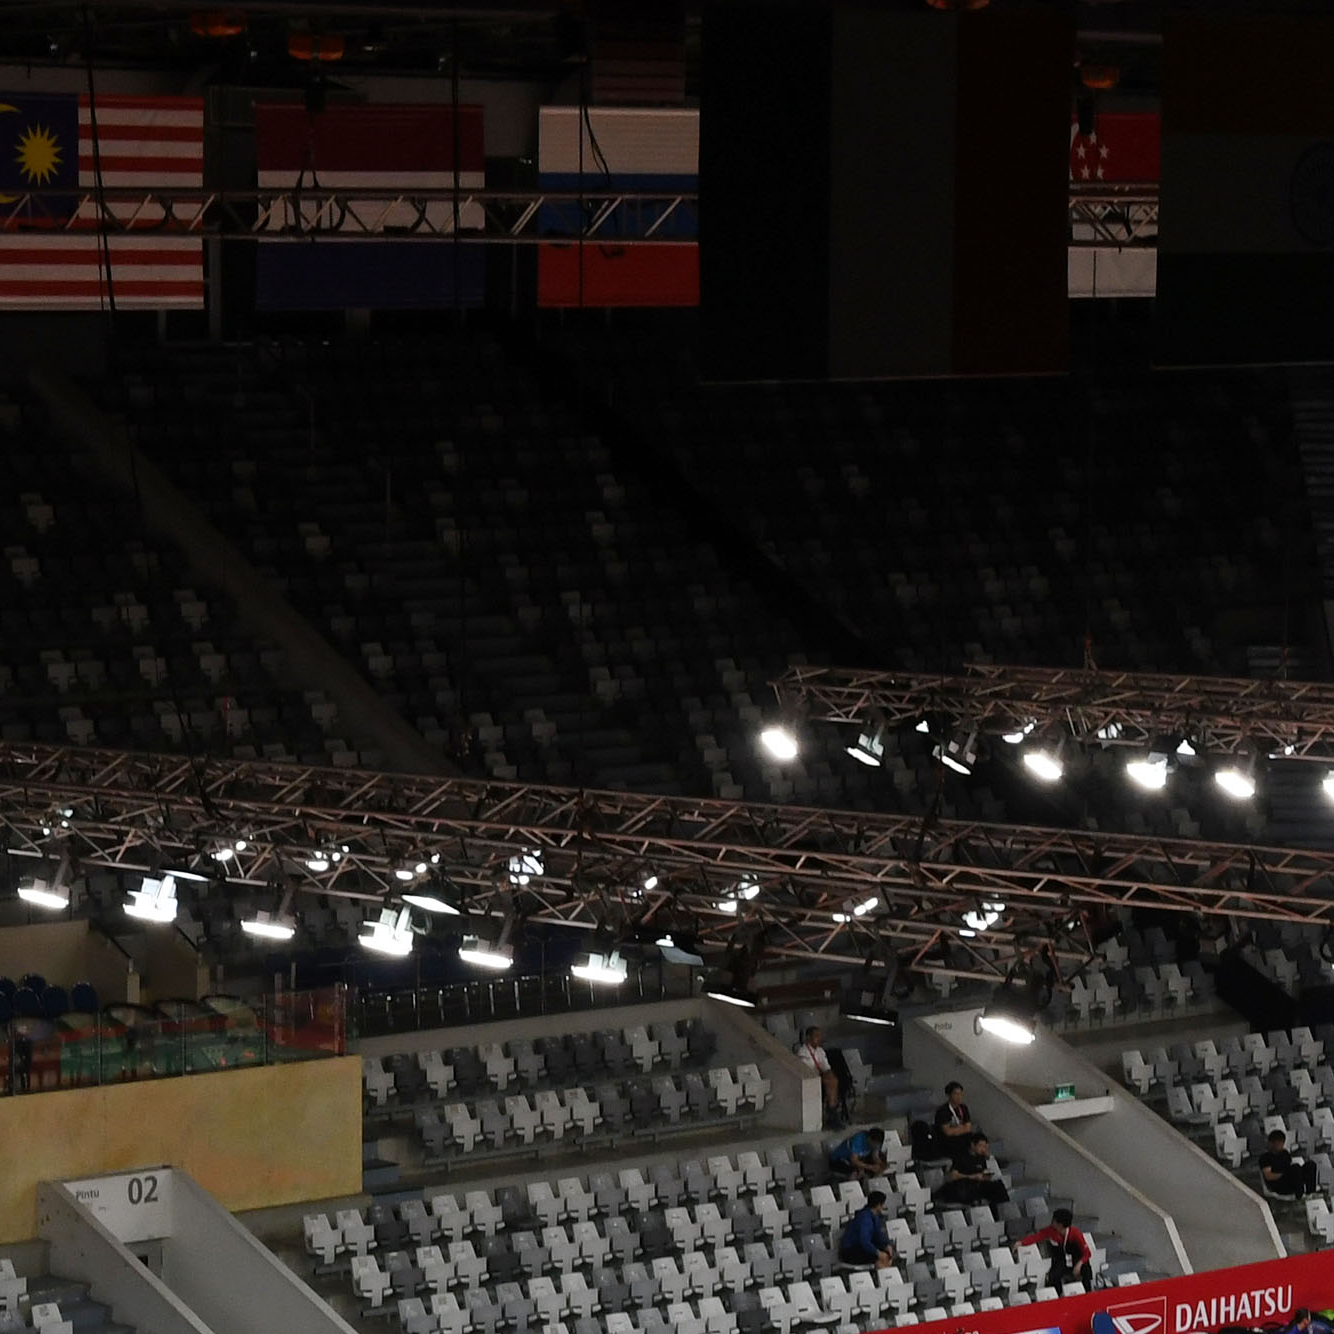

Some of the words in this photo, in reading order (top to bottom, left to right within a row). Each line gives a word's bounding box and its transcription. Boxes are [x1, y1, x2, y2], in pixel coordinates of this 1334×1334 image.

[76, 1189, 100, 1201] Pintu
[127, 1176, 159, 1205] 02
[1175, 1284, 1293, 1333] DAIHATSU
